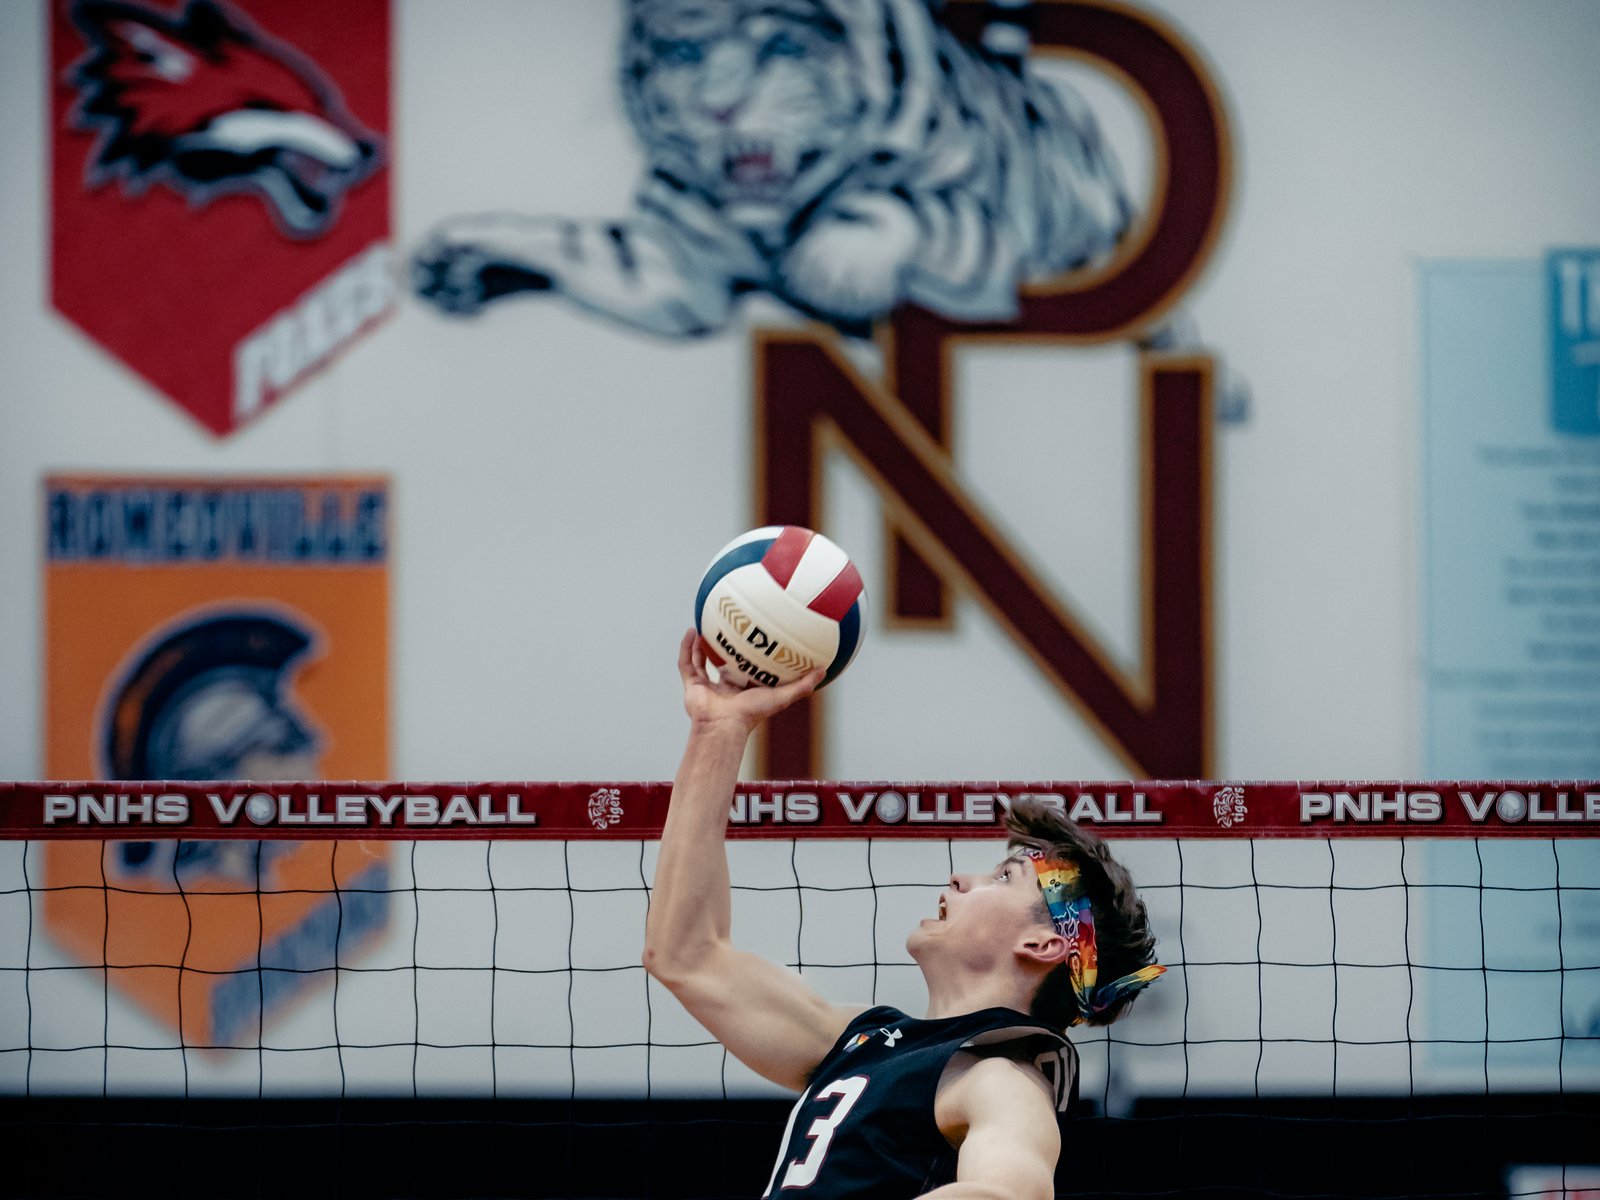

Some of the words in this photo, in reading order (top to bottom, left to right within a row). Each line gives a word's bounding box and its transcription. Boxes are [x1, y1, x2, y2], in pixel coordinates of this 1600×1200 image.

[716, 631, 780, 688] Wilson
[43, 793, 190, 825] PNHS
[206, 792, 536, 826] VOLLEYBALL
[608, 788, 624, 824] tigers
[728, 792, 820, 824] NHS
[1233, 787, 1248, 823] tigers
[1300, 791, 1443, 823] PNHS
